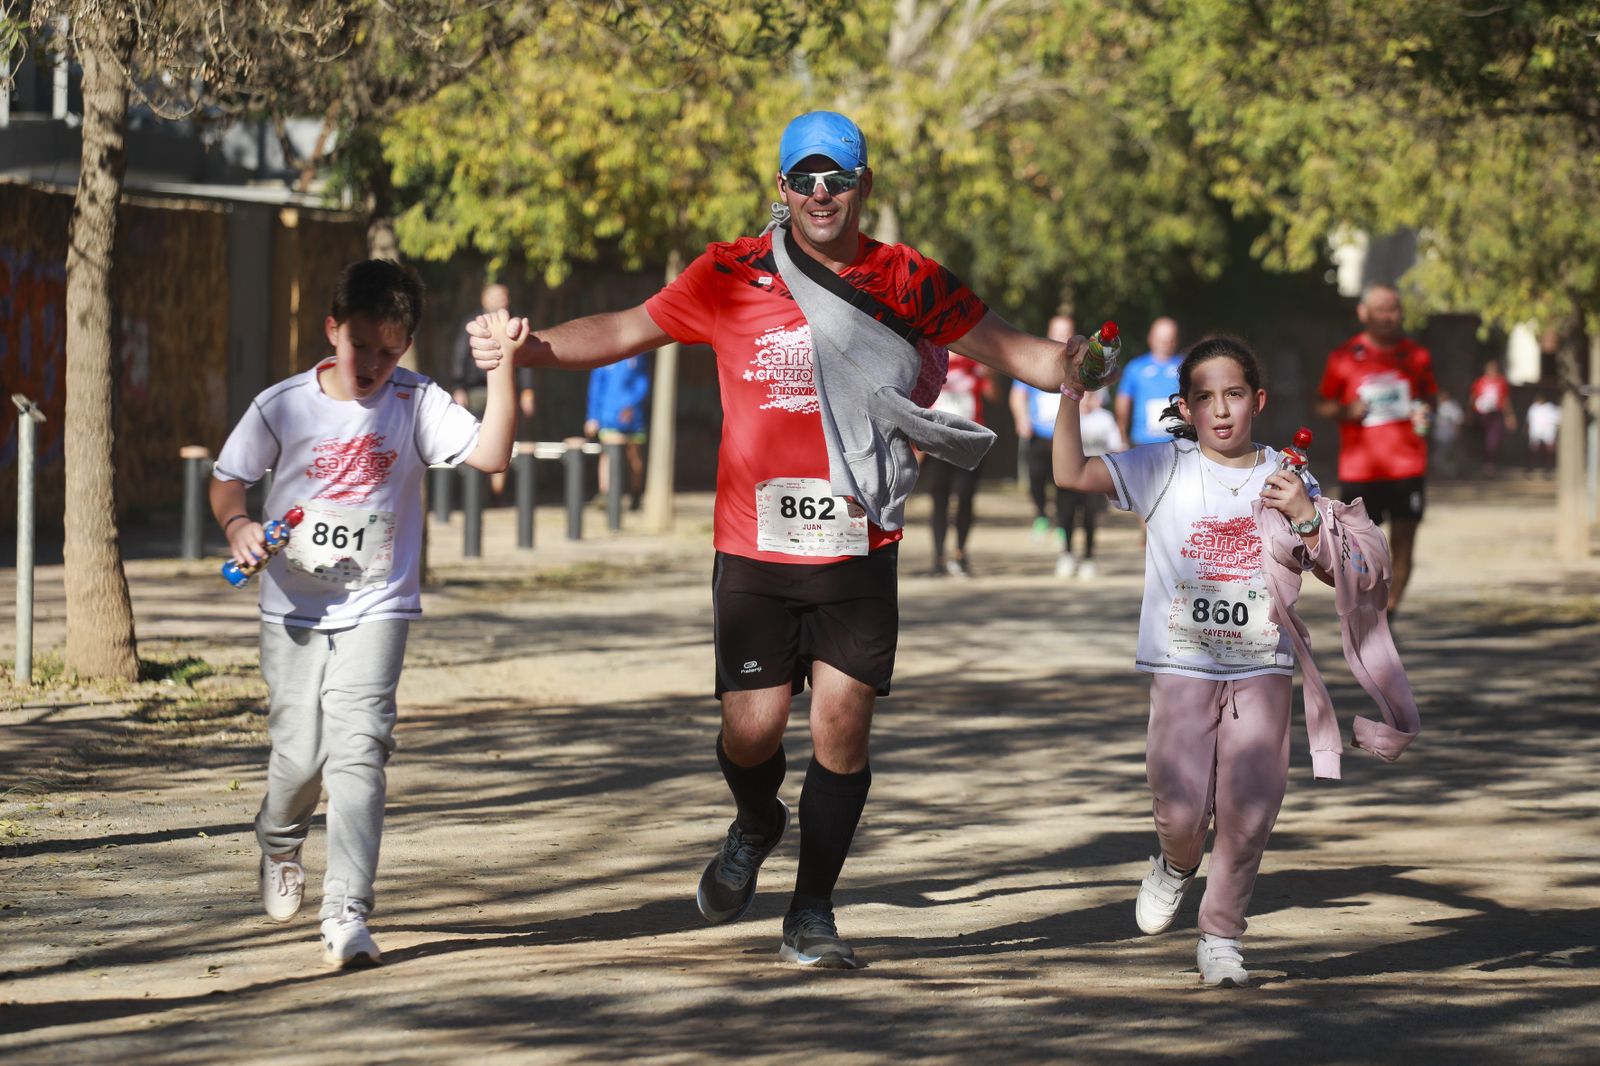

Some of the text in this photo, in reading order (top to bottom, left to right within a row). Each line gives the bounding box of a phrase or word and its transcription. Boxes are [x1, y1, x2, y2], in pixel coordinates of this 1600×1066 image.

[780, 495, 836, 521] 862
[312, 522, 366, 552] 861
[802, 523, 823, 532] JUAN
[1192, 597, 1249, 627] 860
[1202, 628, 1243, 639] CAYETANA
